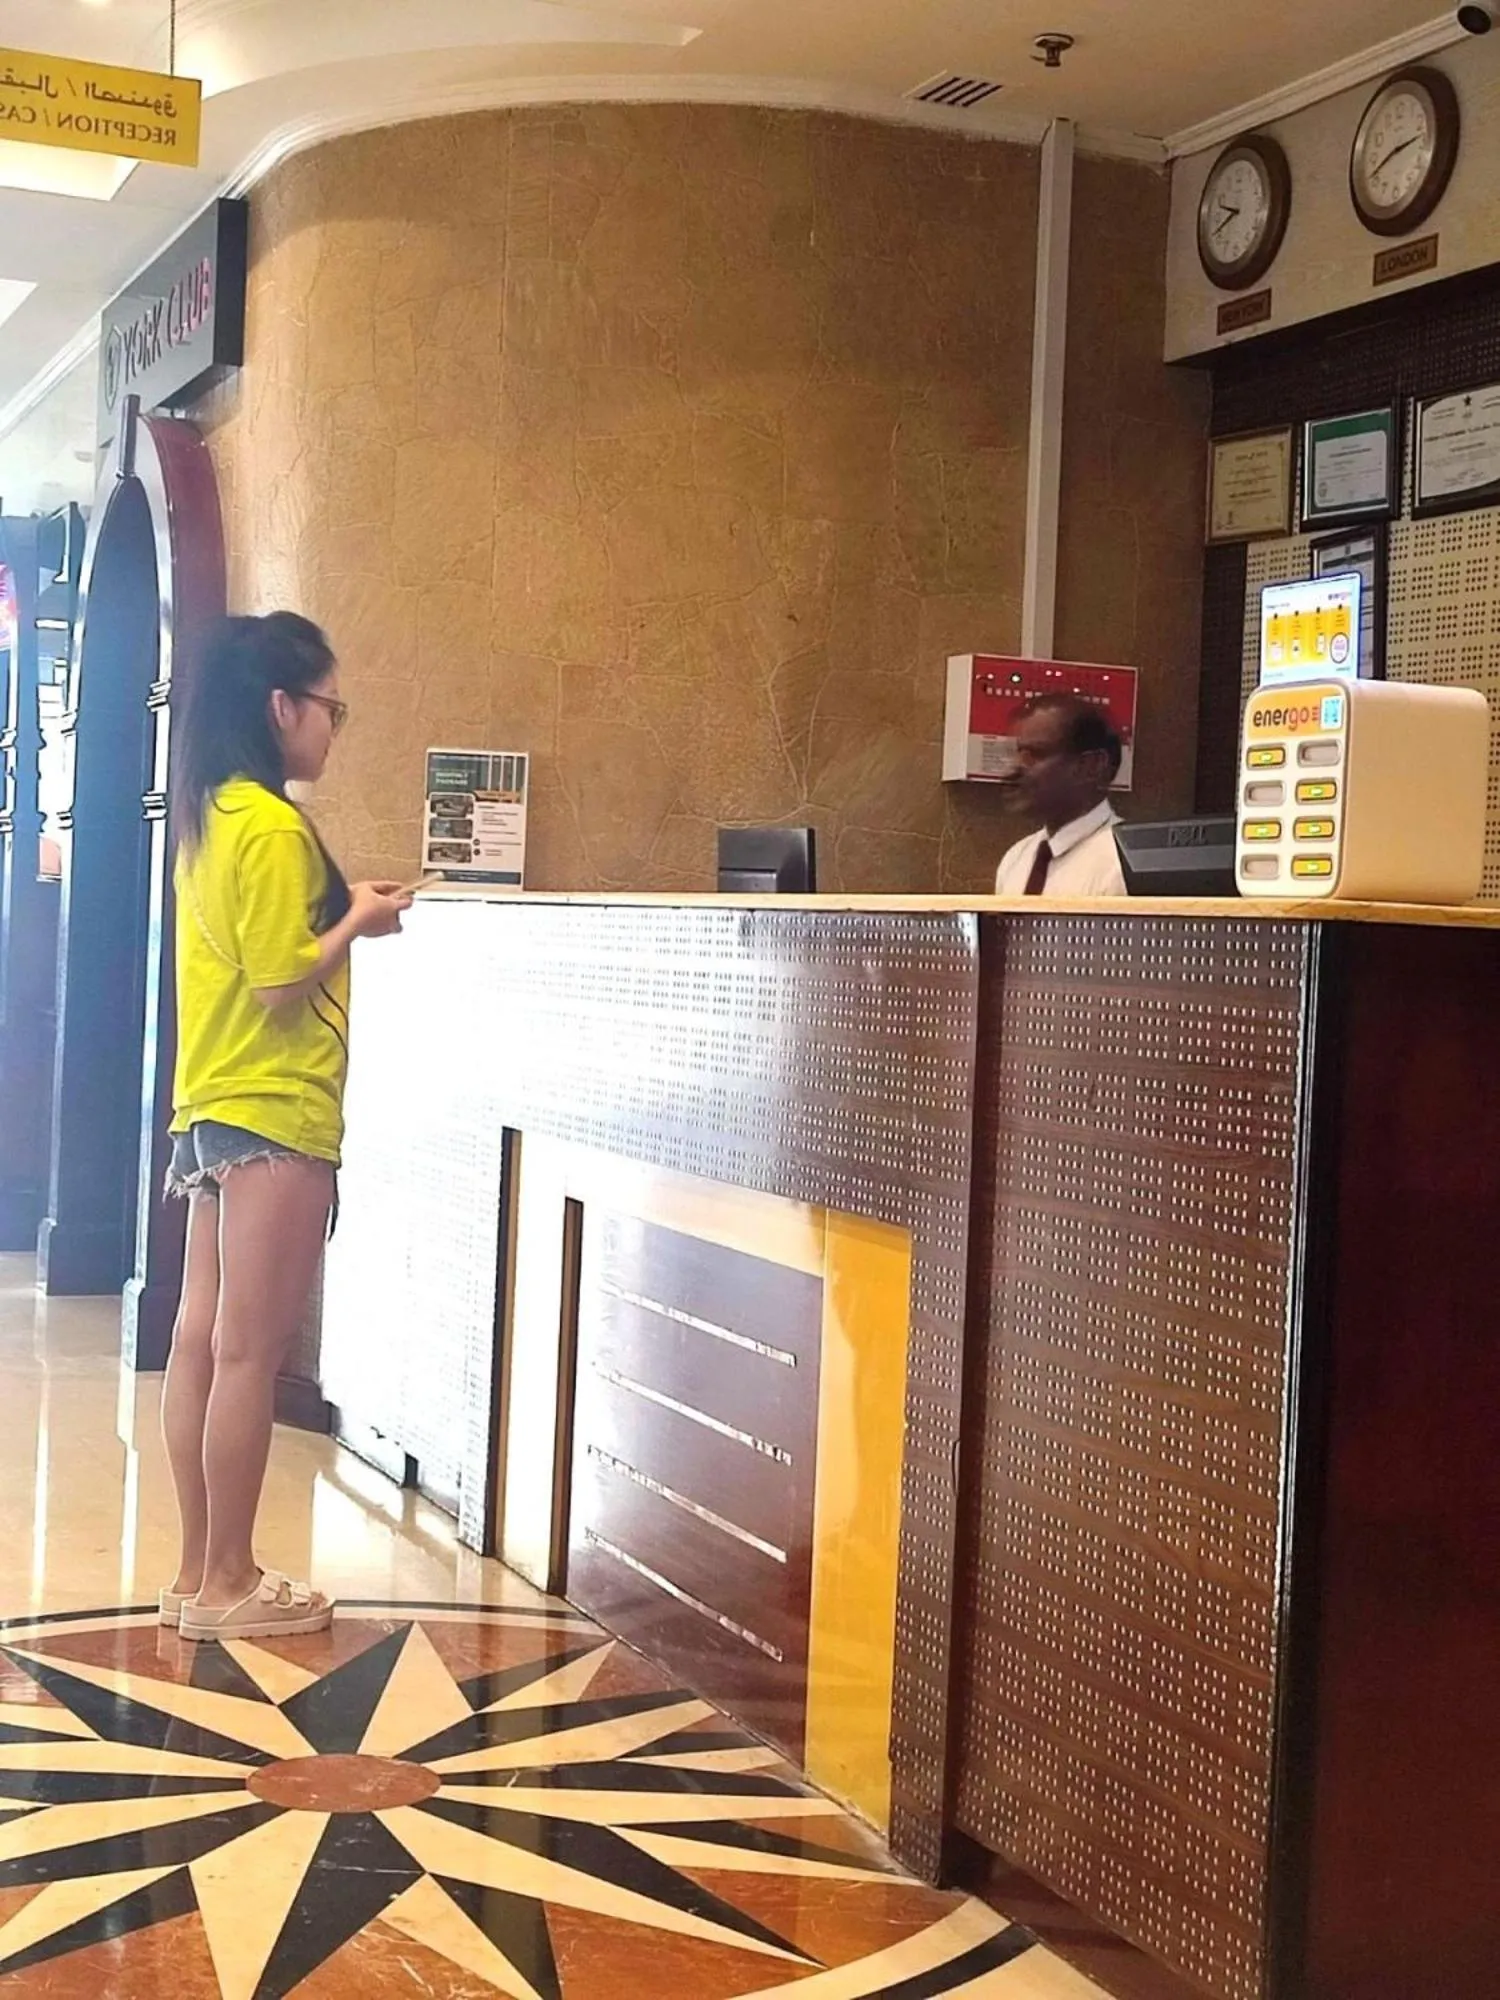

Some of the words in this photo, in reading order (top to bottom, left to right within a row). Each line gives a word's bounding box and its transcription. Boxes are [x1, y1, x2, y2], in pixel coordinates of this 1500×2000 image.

[1380, 245, 1428, 274] LONDON
[123, 299, 164, 385] YORK
[167, 257, 213, 348] CLUB
[1253, 705, 1310, 732] energo
